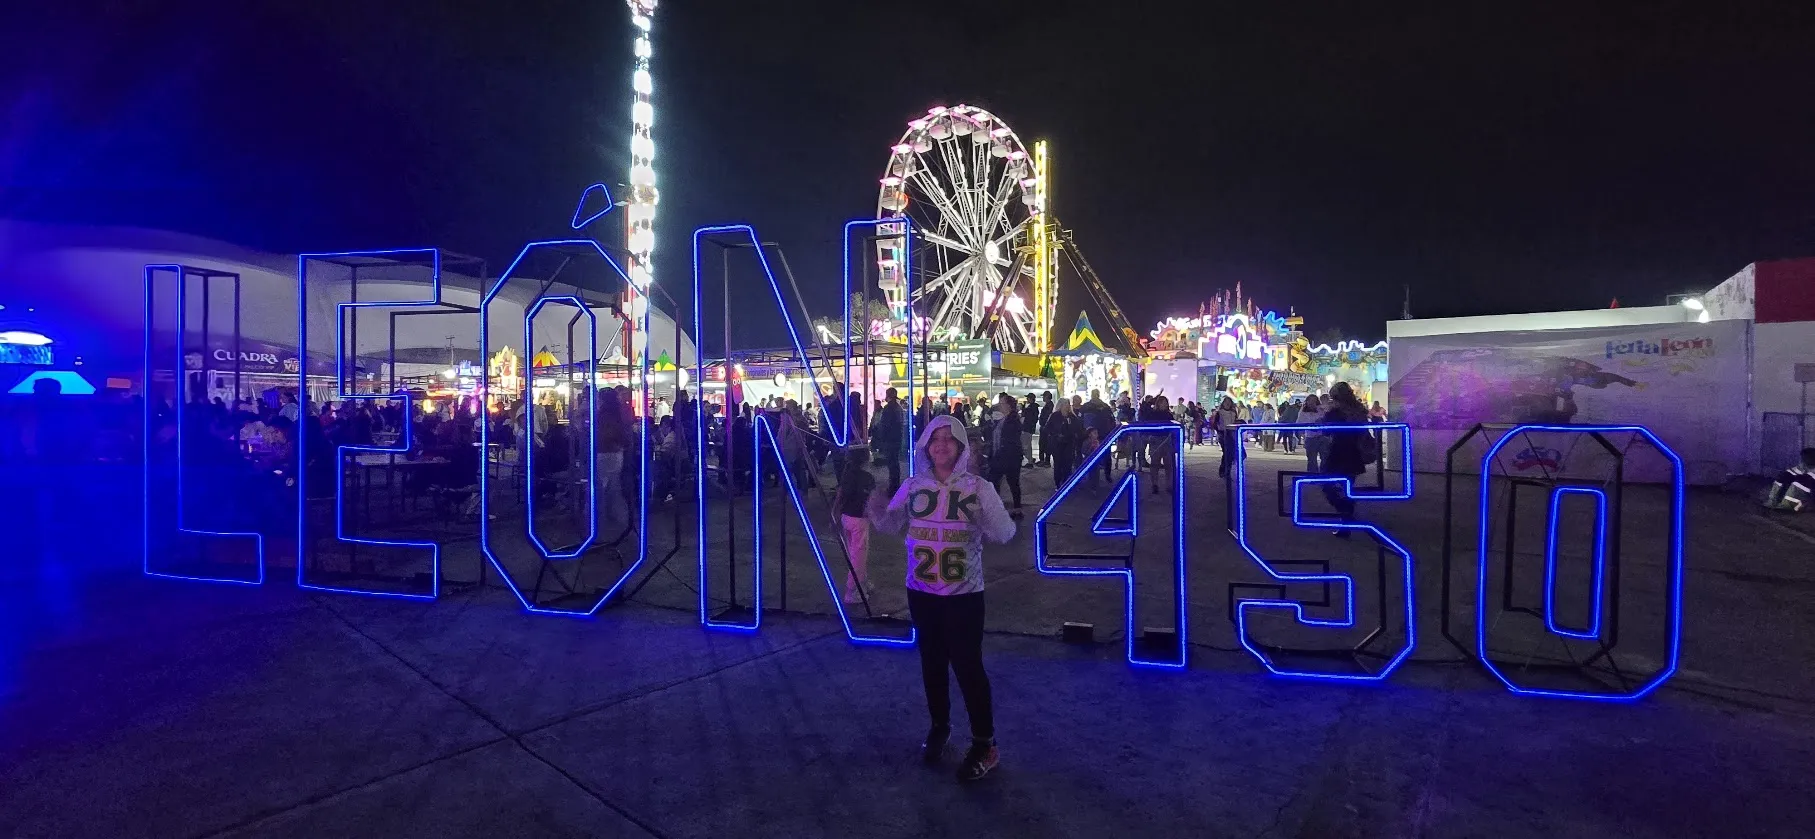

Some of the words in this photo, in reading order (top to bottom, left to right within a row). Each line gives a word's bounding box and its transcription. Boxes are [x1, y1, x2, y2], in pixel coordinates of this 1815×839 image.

[213, 348, 279, 365] CUADRA
[914, 545, 967, 583] 26
[1033, 422, 1686, 702] 450
